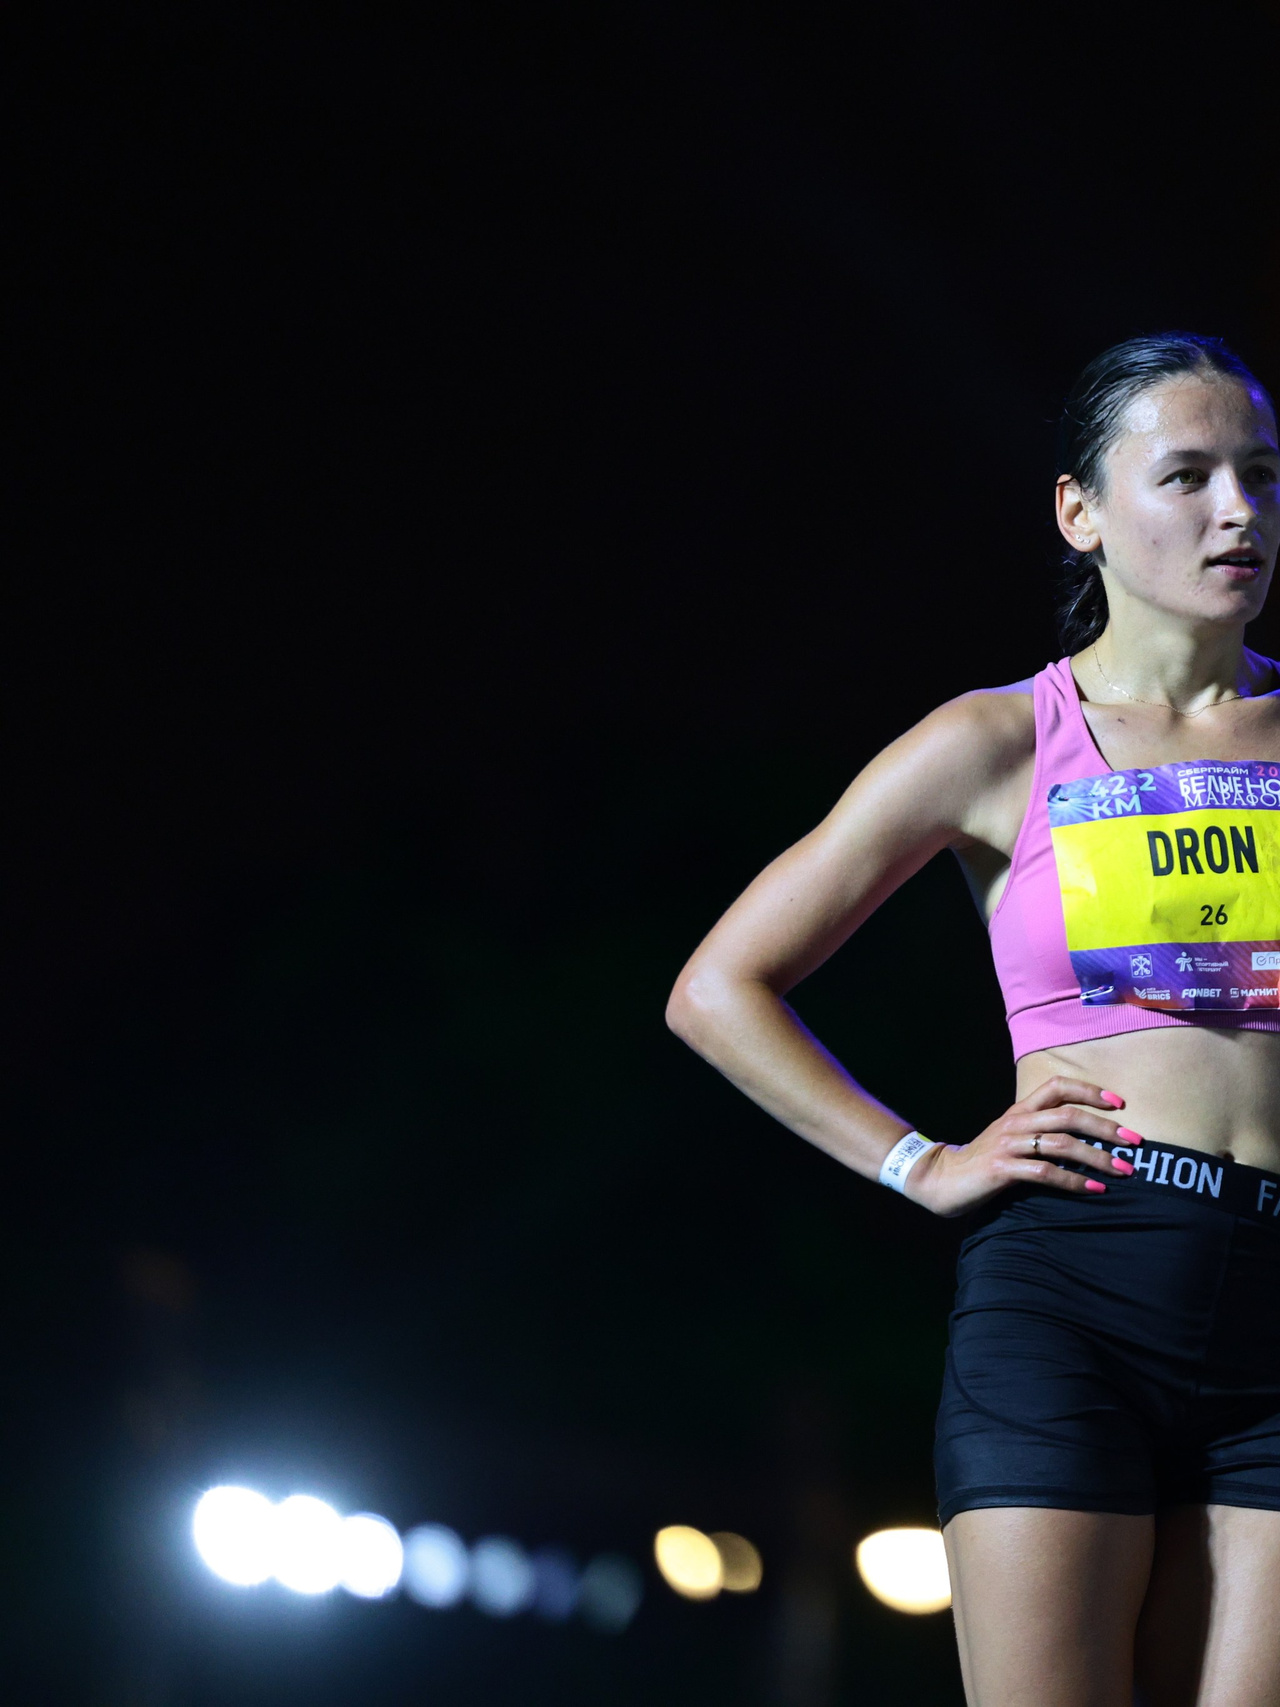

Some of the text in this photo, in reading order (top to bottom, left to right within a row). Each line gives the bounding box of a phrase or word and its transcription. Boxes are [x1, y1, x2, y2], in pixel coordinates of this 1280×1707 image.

[1177, 766, 1249, 777] СБЕРПРАЙМ
[1089, 772, 1157, 798] 42,2
[1179, 775, 1243, 797] БЕЛЫЕ
[1147, 825, 1259, 877] DRON
[1200, 904, 1229, 926] 26
[1147, 993, 1171, 1001] BRICS
[1182, 988, 1222, 998] FONBET
[1240, 987, 1279, 997] МАГНИТ
[1059, 1139, 1223, 1199] HION
